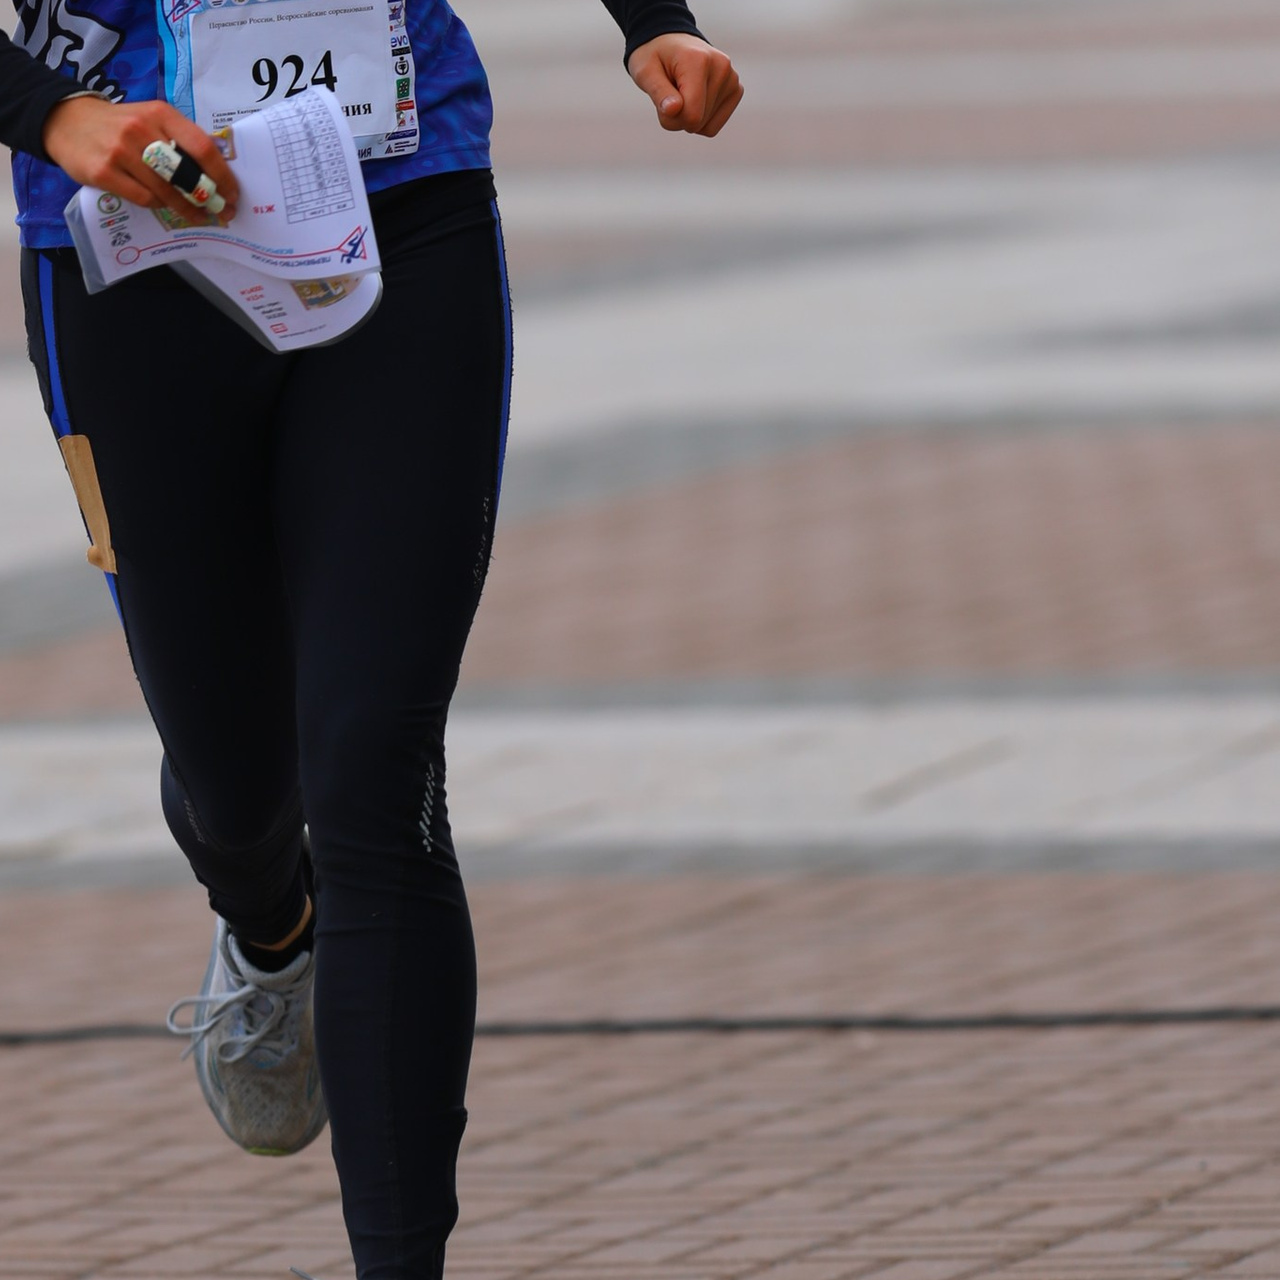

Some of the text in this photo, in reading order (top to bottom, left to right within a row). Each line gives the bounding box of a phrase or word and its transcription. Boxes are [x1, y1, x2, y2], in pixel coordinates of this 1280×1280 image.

[208, 4, 374, 30] Первенство России, Всероссийские соревнования
[251, 50, 338, 103] 924
